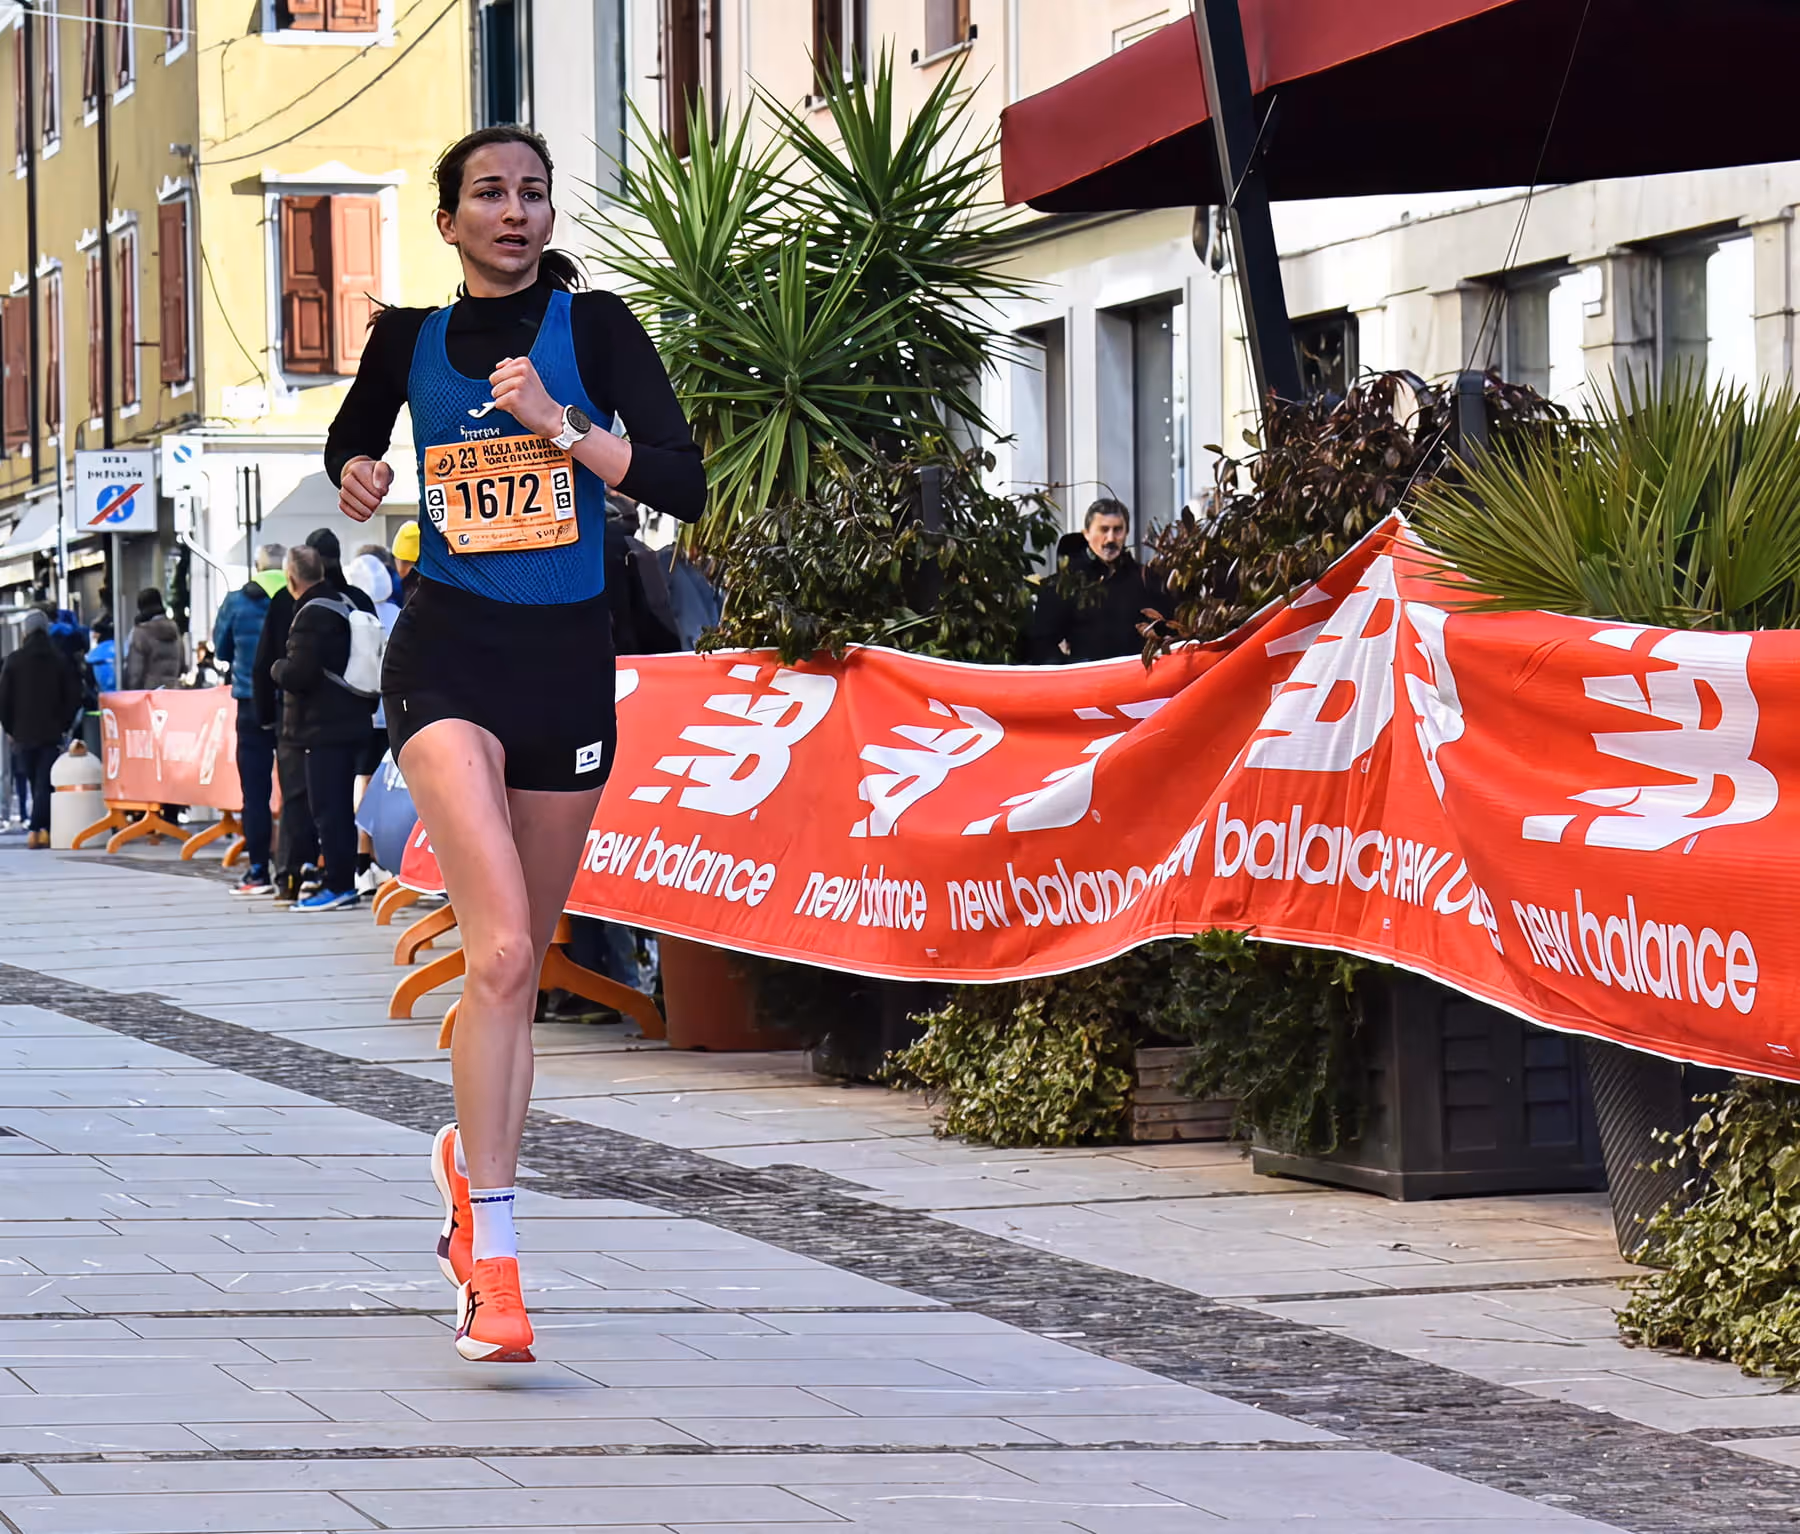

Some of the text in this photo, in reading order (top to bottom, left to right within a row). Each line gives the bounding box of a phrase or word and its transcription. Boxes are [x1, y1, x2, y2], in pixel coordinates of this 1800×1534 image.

[455, 473, 542, 520] 1672
[583, 826, 776, 907] new balance
[793, 871, 862, 923] new
[946, 879, 1012, 931] new
[1510, 899, 1585, 977] new
[1574, 888, 1759, 1015] balance
